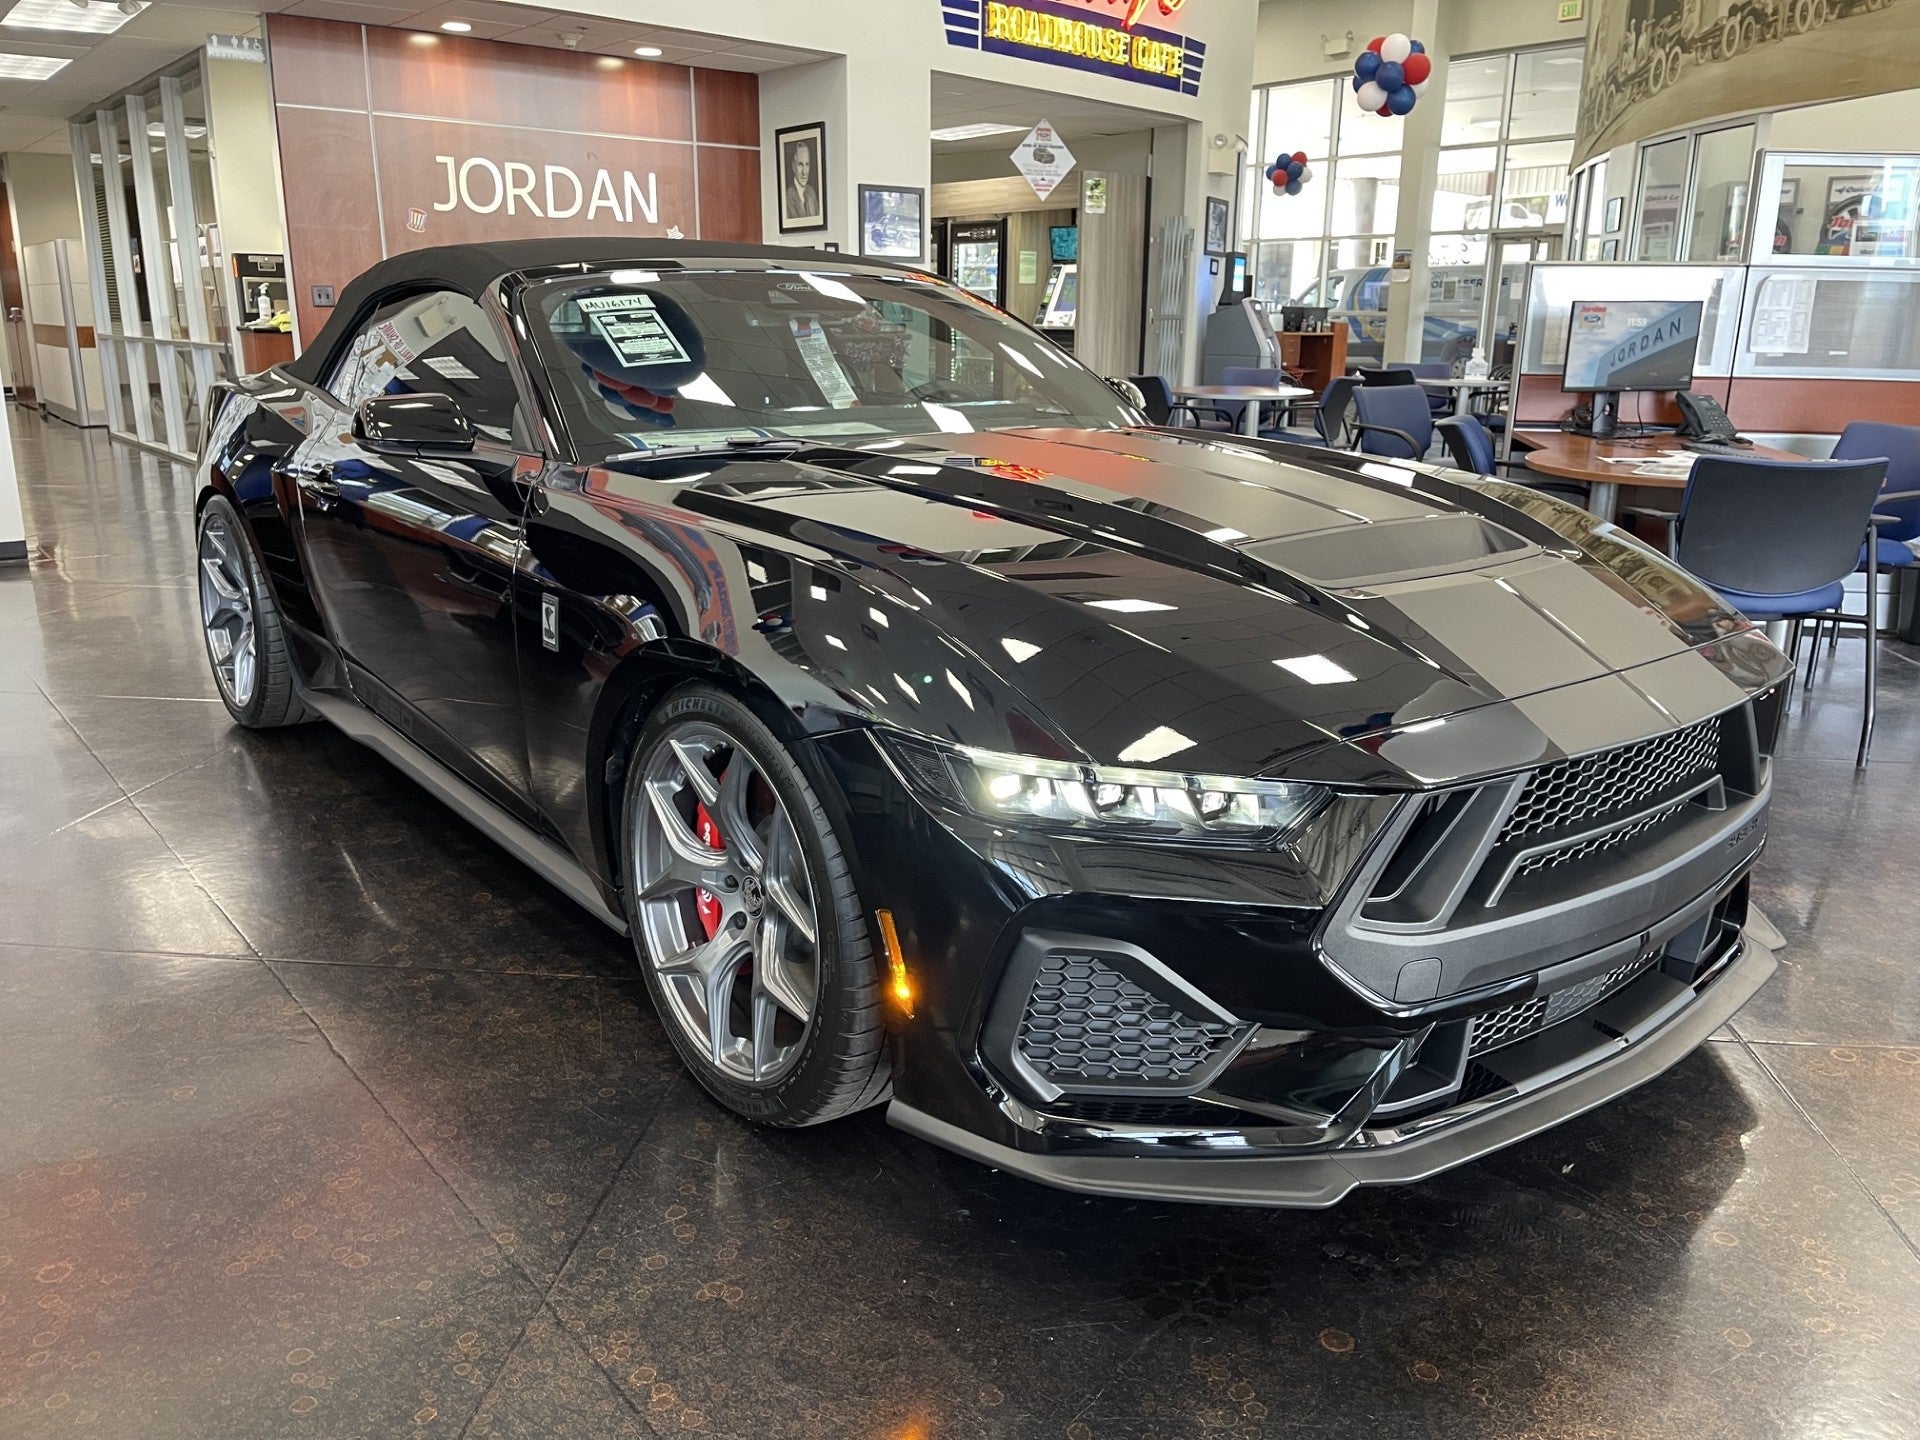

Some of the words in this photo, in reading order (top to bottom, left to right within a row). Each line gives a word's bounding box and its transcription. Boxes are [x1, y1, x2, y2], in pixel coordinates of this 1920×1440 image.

[984, 2, 1130, 62] ROADHOUSE
[1130, 36, 1184, 78] CAFE
[433, 155, 658, 224] JORDAN
[1609, 317, 1682, 367] JORDAN
